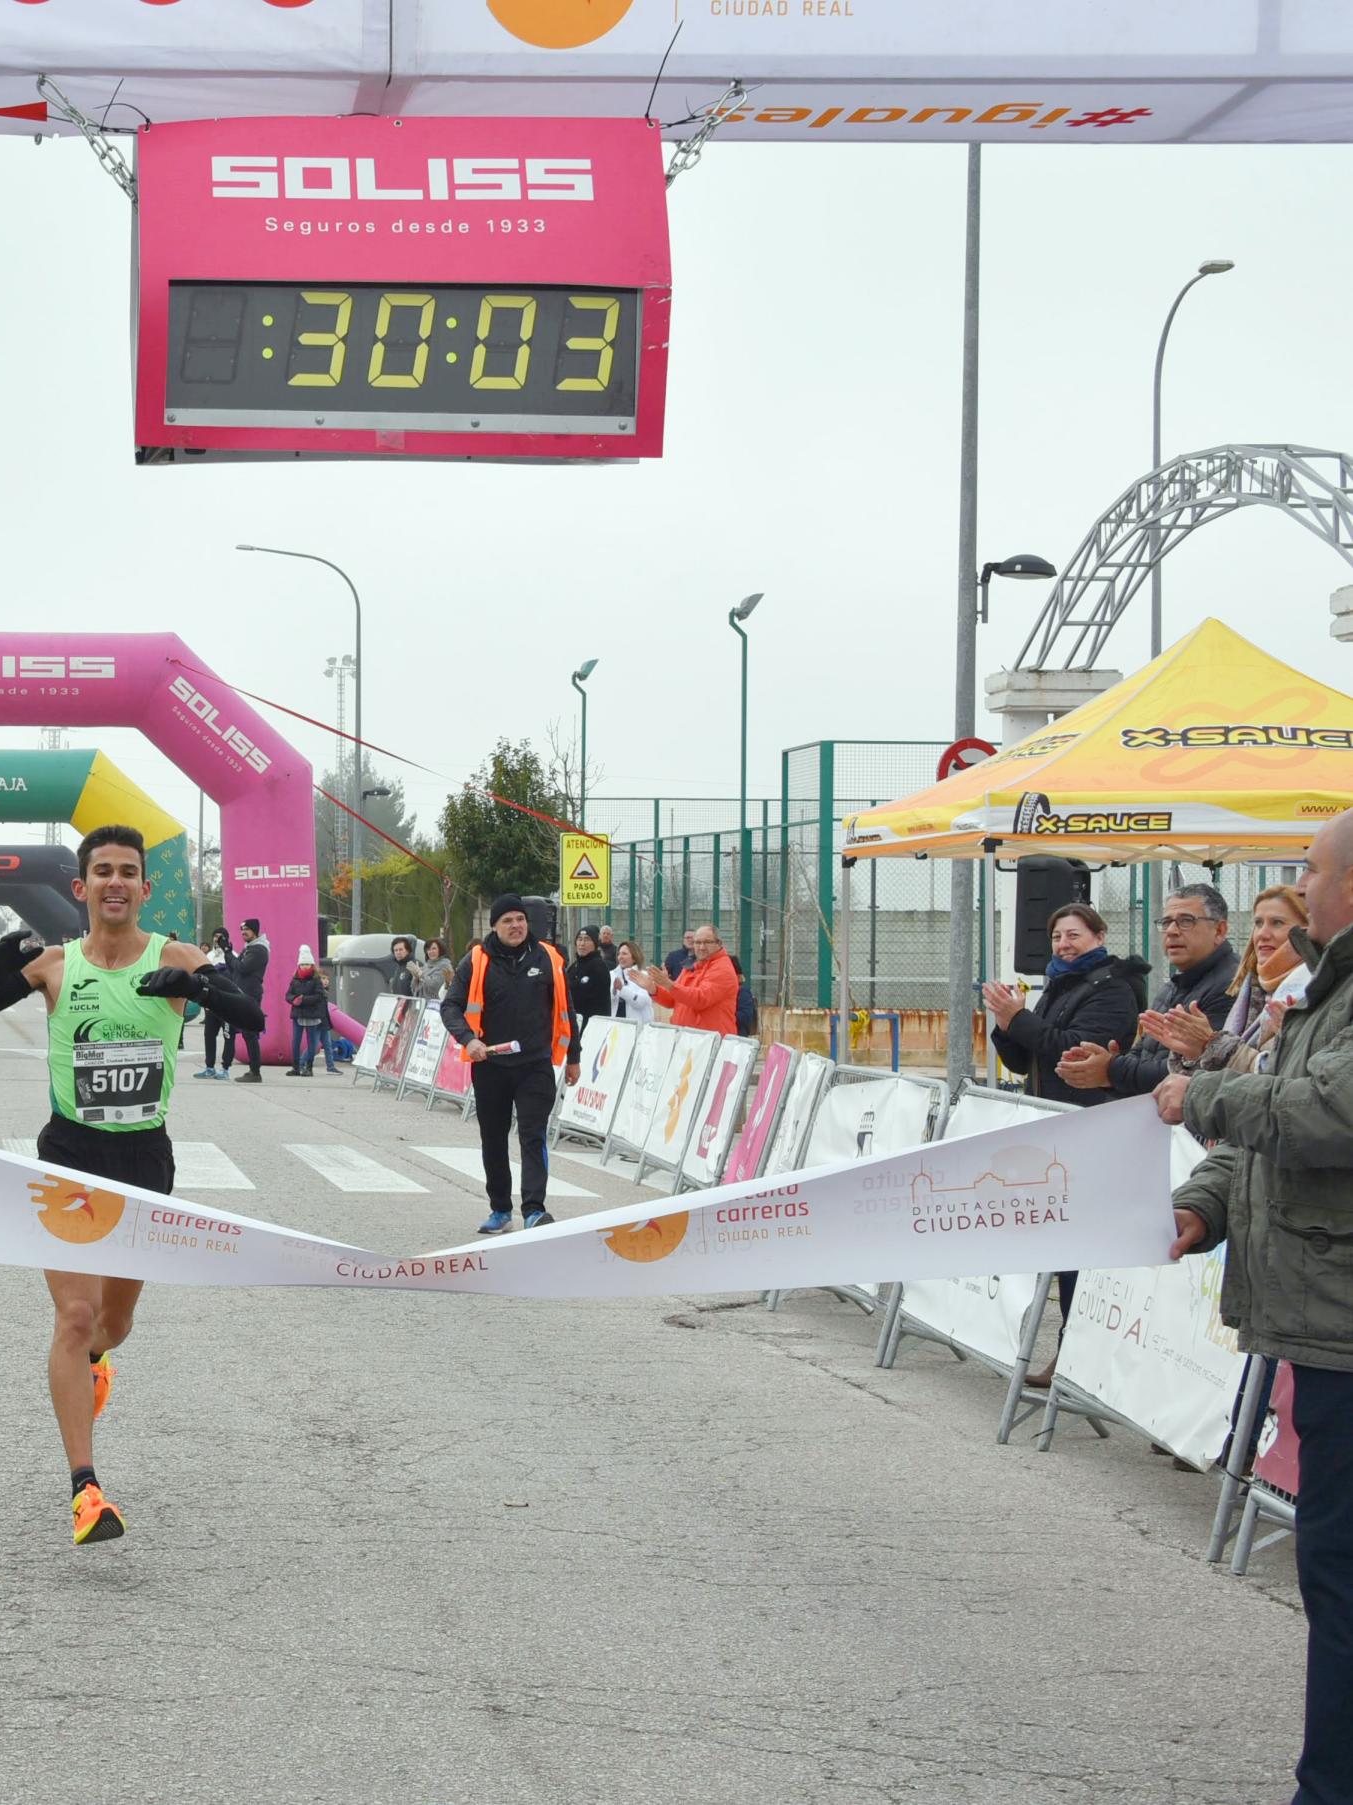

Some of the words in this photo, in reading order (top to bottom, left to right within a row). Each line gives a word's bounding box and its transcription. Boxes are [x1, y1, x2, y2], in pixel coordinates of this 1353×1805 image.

[710, 0, 789, 16] CIUDAD
[802, 0, 854, 17] REAL
[211, 156, 594, 201] SOLISS
[265, 216, 377, 236] Seguros
[391, 217, 470, 235] desde
[486, 219, 546, 234] 1933
[39, 685, 80, 696] 1933
[168, 675, 273, 775] SOLISS
[171, 705, 201, 735] Seguros
[202, 735, 224, 756] desde
[225, 755, 243, 773] 1933
[1036, 811, 1173, 834] X-SAUCE
[234, 864, 311, 881] SOLISS
[566, 891, 603, 900] ELEVADO
[573, 882, 596, 891] PASO
[102, 1030, 149, 1039] MENORCA
[75, 1050, 105, 1060] BigMat
[92, 1067, 150, 1093] 5107
[1048, 1194, 1069, 1206] DE
[716, 1200, 810, 1223] carreras
[912, 1212, 1006, 1234] CIUDAD
[1014, 1207, 1070, 1226] REAL
[150, 1209, 243, 1236] carreras
[147, 1230, 199, 1249] CIUDAD
[205, 1239, 239, 1254] REAL
[717, 1228, 770, 1244] CIUDAD
[777, 1224, 812, 1238] REAL
[336, 1261, 425, 1279] CIUDAD
[434, 1256, 490, 1275] REAL
